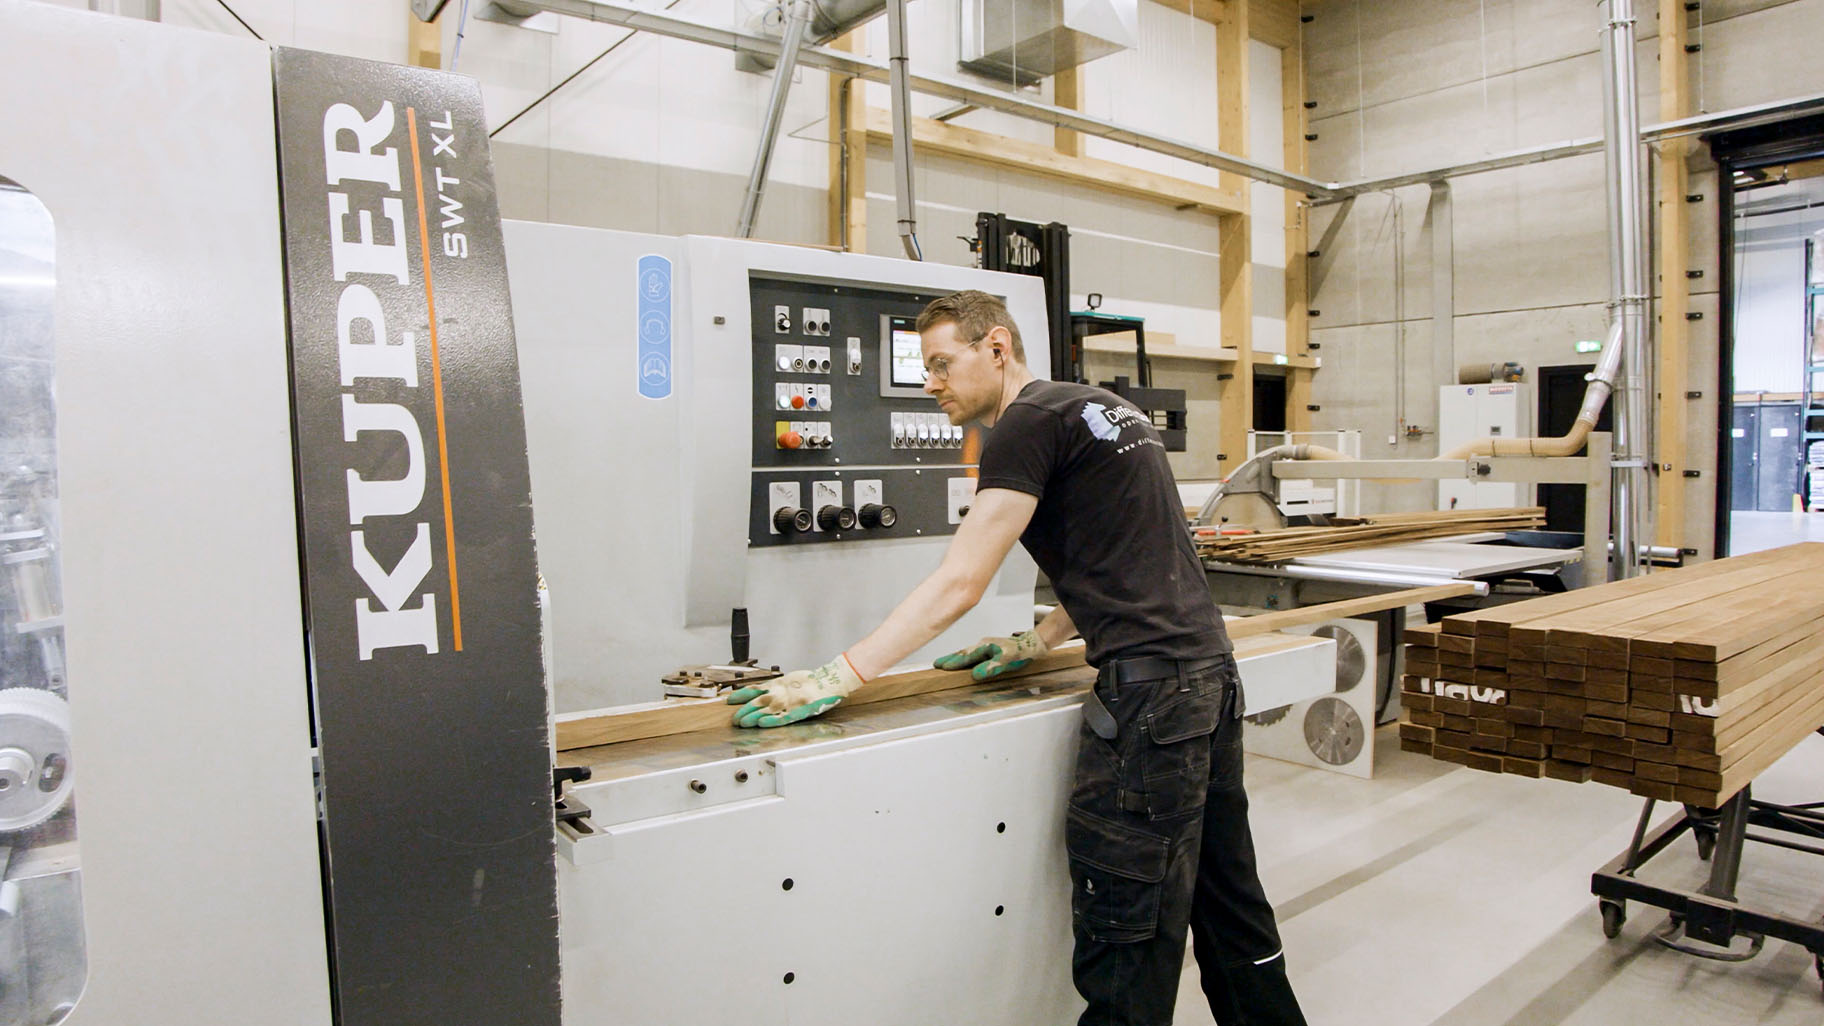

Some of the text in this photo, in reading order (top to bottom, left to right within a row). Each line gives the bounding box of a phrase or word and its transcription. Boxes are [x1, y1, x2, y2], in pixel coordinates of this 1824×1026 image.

[430, 111, 468, 259] SWT XL
[323, 100, 439, 661] KUPER
[1105, 405, 1151, 424] Diffe
